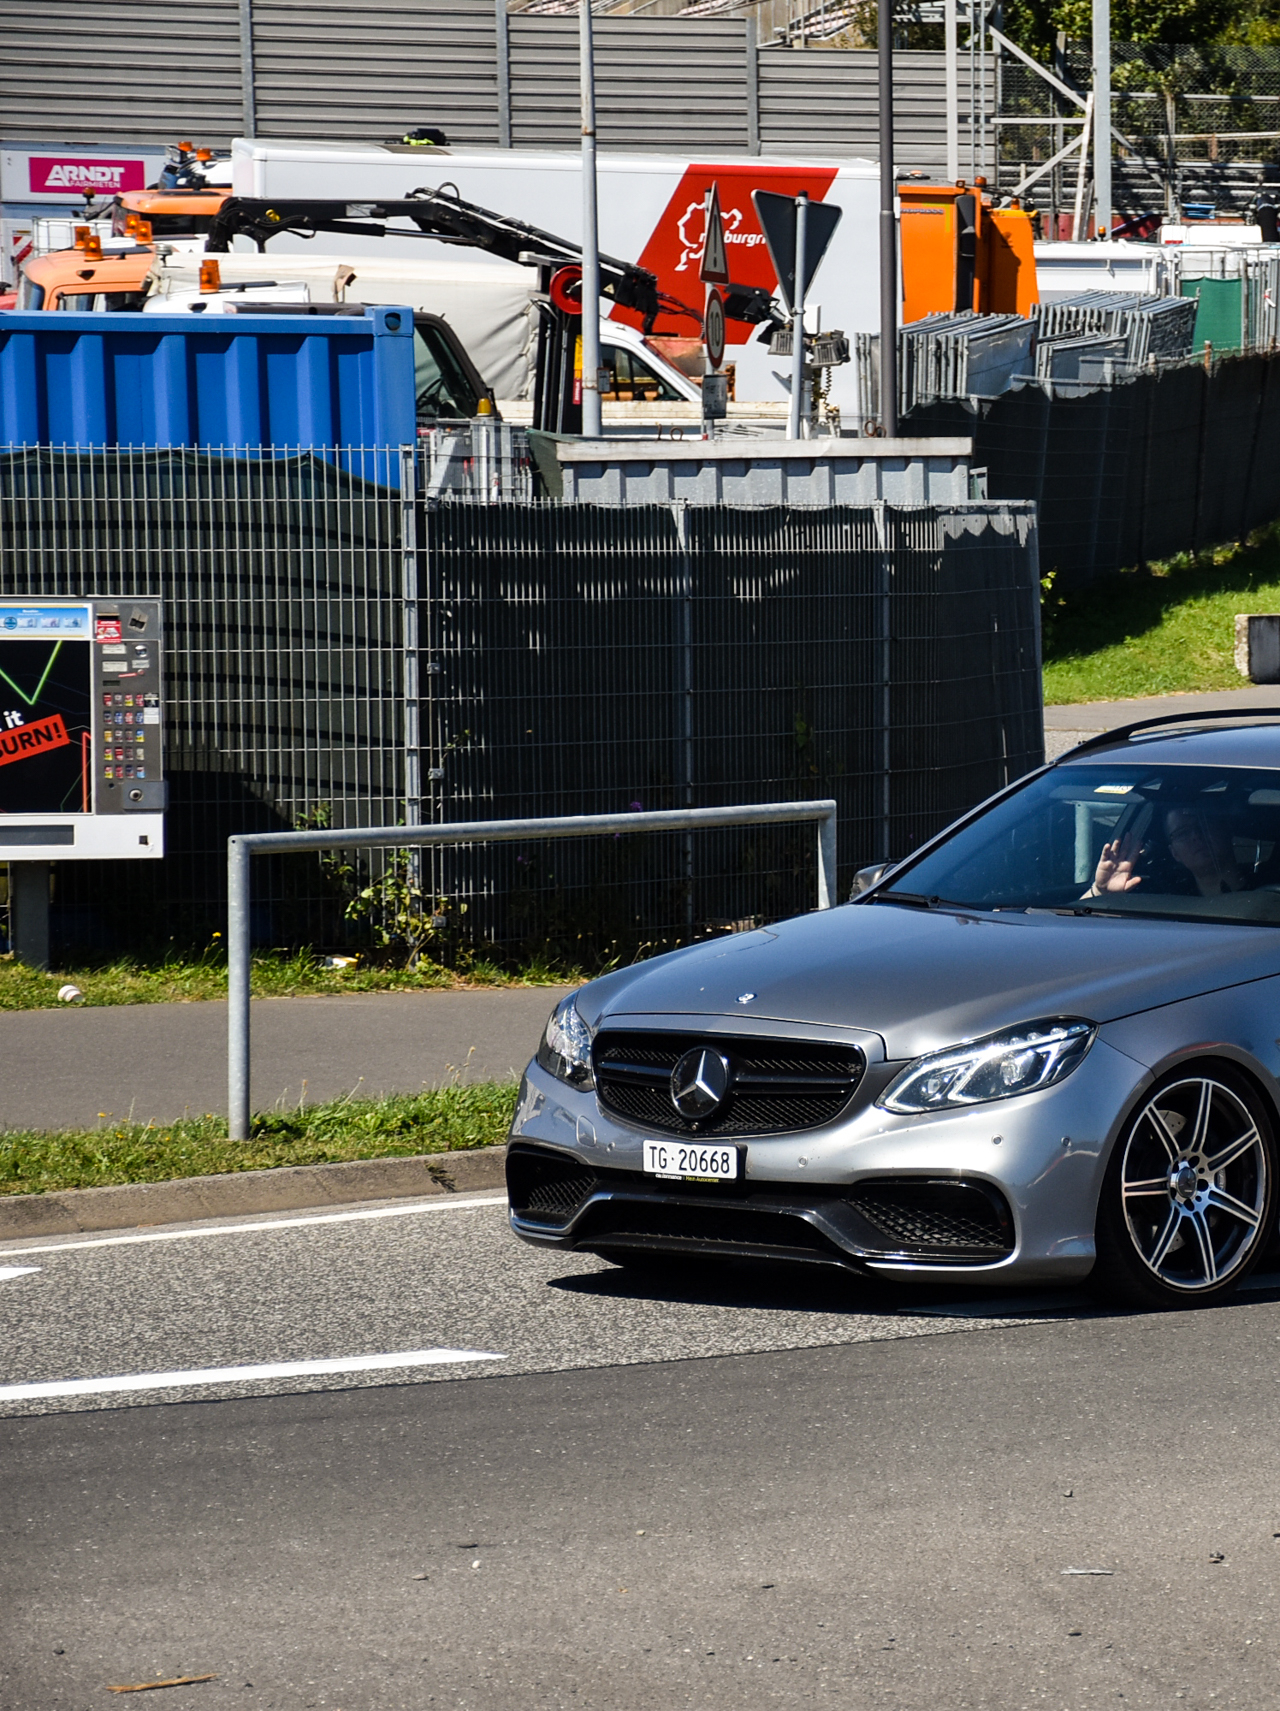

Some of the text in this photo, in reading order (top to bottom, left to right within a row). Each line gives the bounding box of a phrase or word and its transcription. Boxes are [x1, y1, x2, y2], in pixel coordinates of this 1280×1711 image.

[44, 165, 125, 187] ARNDT
[70, 180, 120, 188] FAIRMIETEN
[3, 710, 24, 729] it
